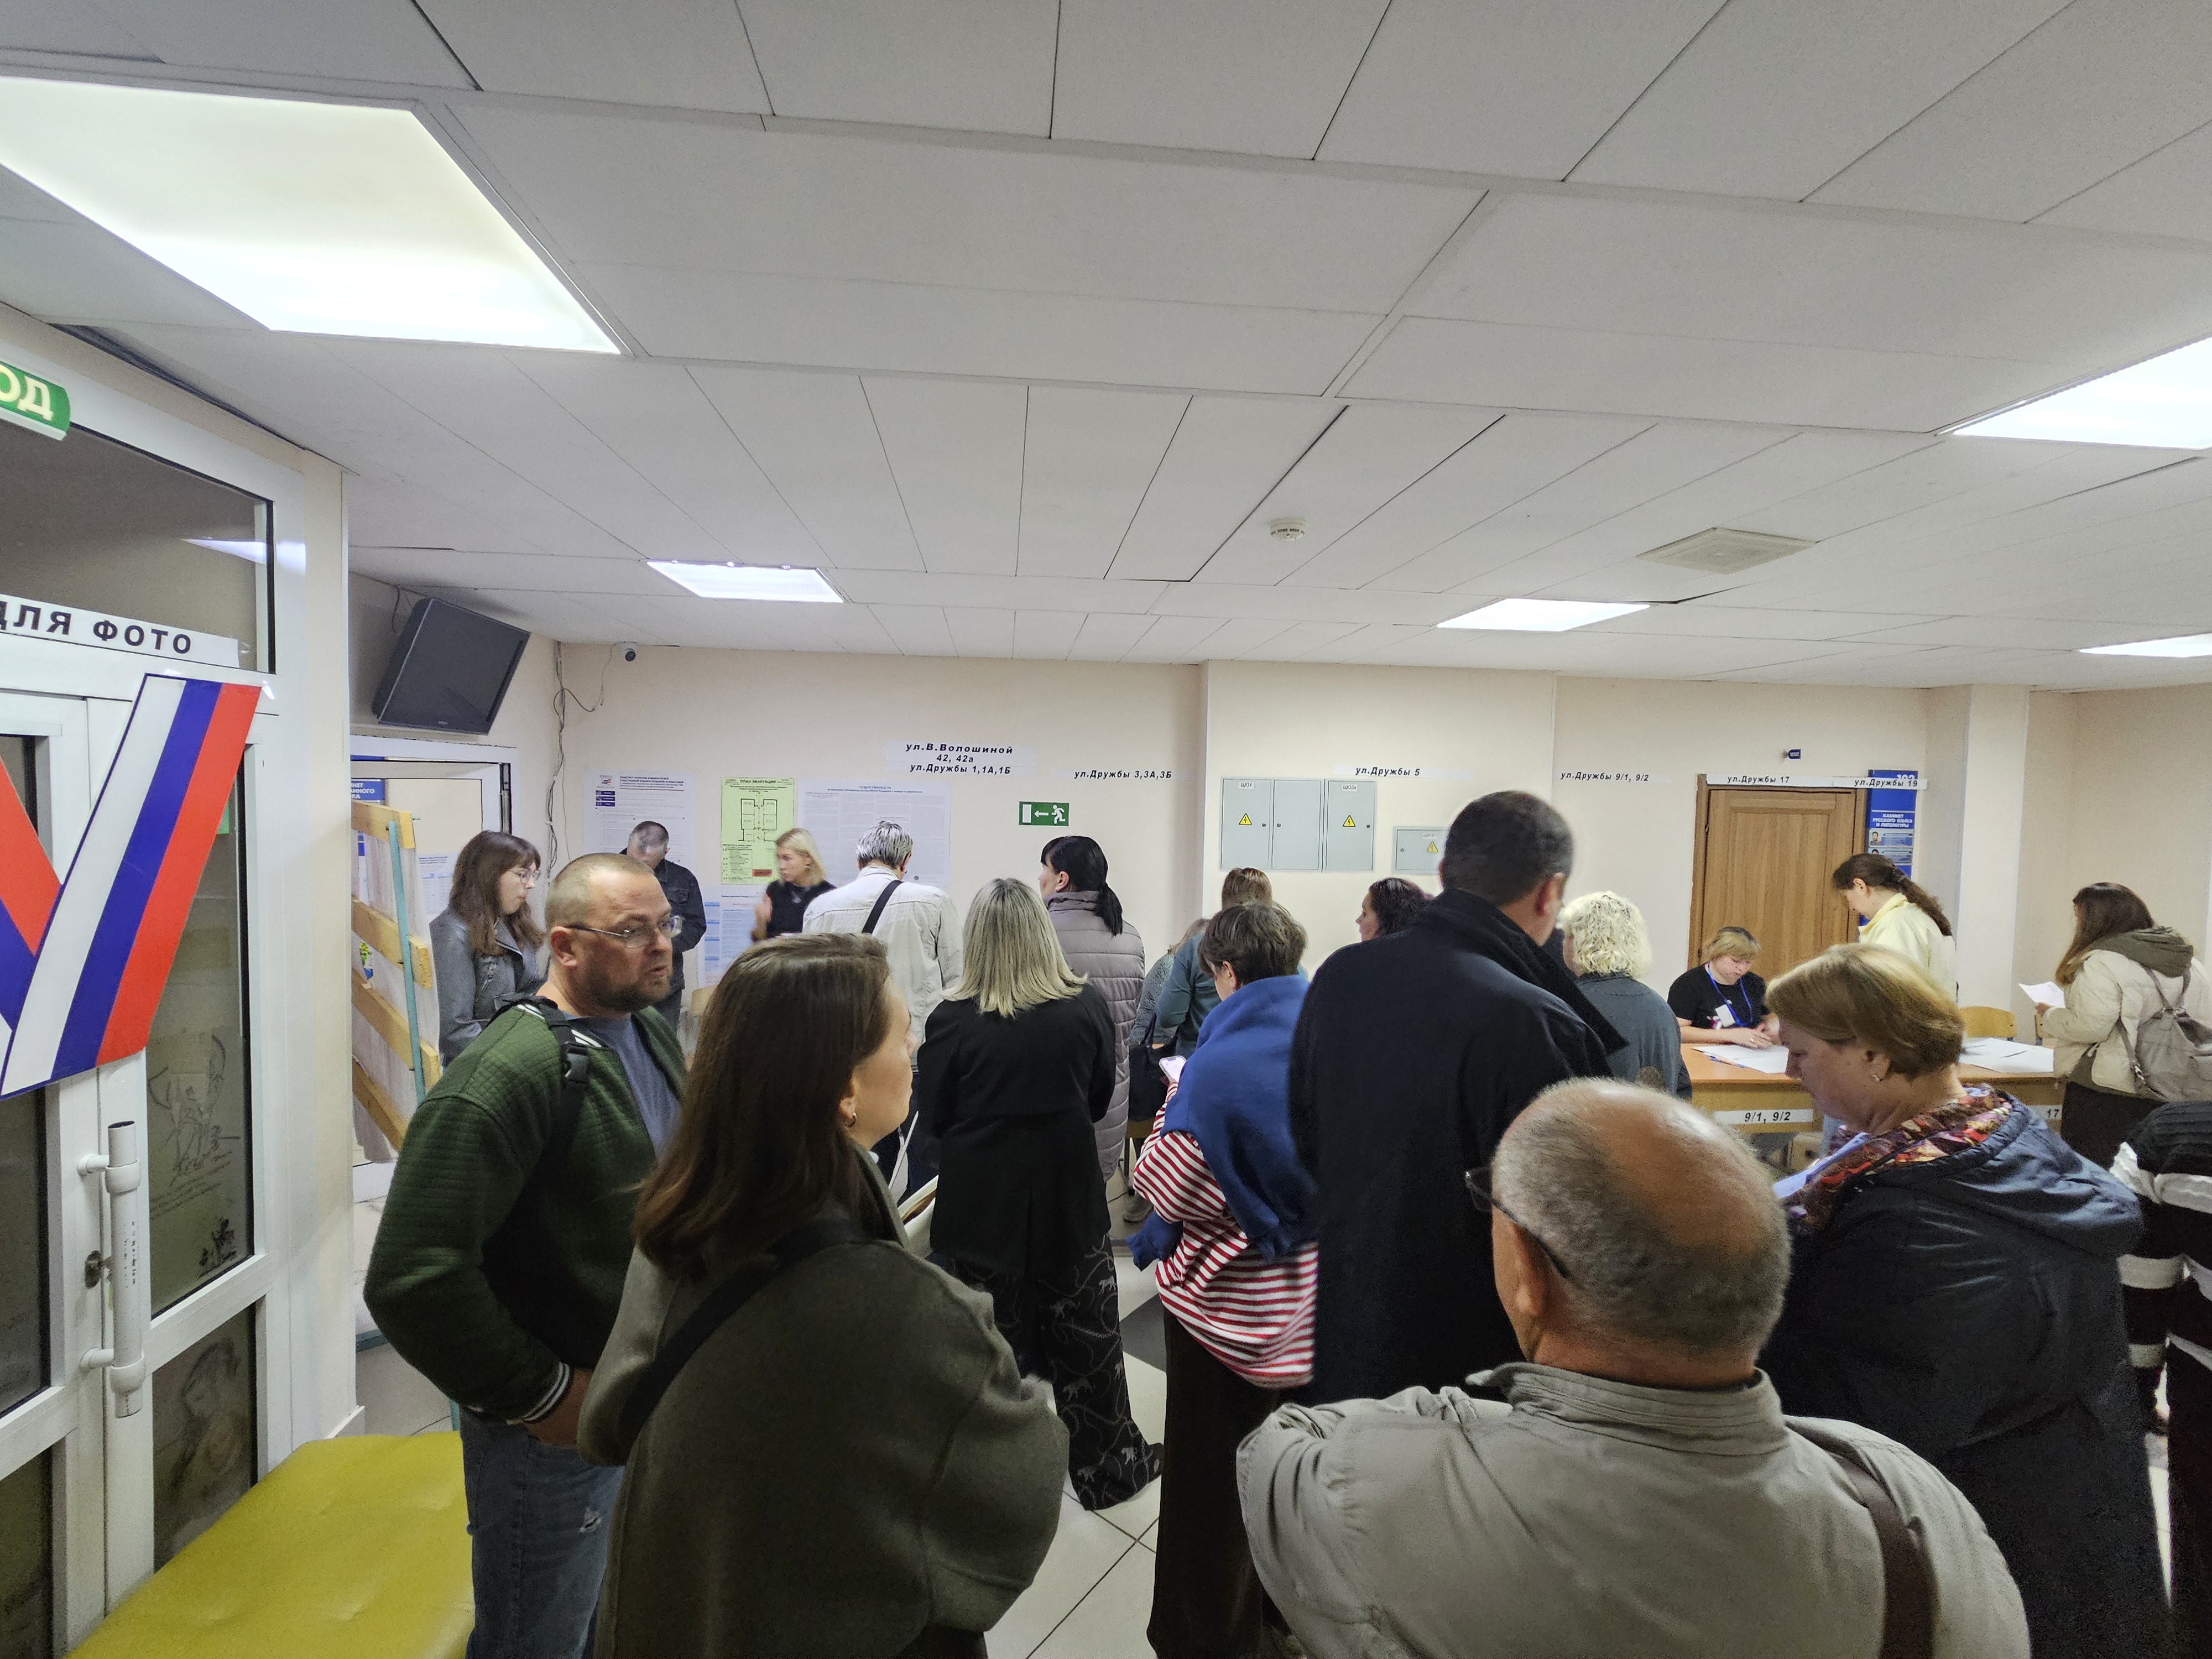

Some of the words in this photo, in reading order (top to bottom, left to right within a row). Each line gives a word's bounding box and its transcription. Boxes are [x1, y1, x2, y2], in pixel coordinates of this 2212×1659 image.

[0, 601, 71, 635] ЛЯ
[93, 619, 191, 654] ФОТО
[936, 754, 952, 764] 42,
[910, 764, 968, 773] ул.Дружбы
[1355, 766, 1410, 776] ул.Дружбы
[1074, 770, 1130, 779] ул.Дружбы
[1134, 770, 1172, 780] 3,3А,3Б
[1561, 772, 1611, 781] ул.Дружбы
[1615, 773, 1631, 782] 9/1,
[1728, 775, 1776, 784] ул.Дружбы
[1854, 779, 1903, 787] ул.Дружбы
[1745, 1112, 1766, 1124] 9/1,
[1772, 1111, 1791, 1121] 9/2
[2047, 1108, 2060, 1118] 17
